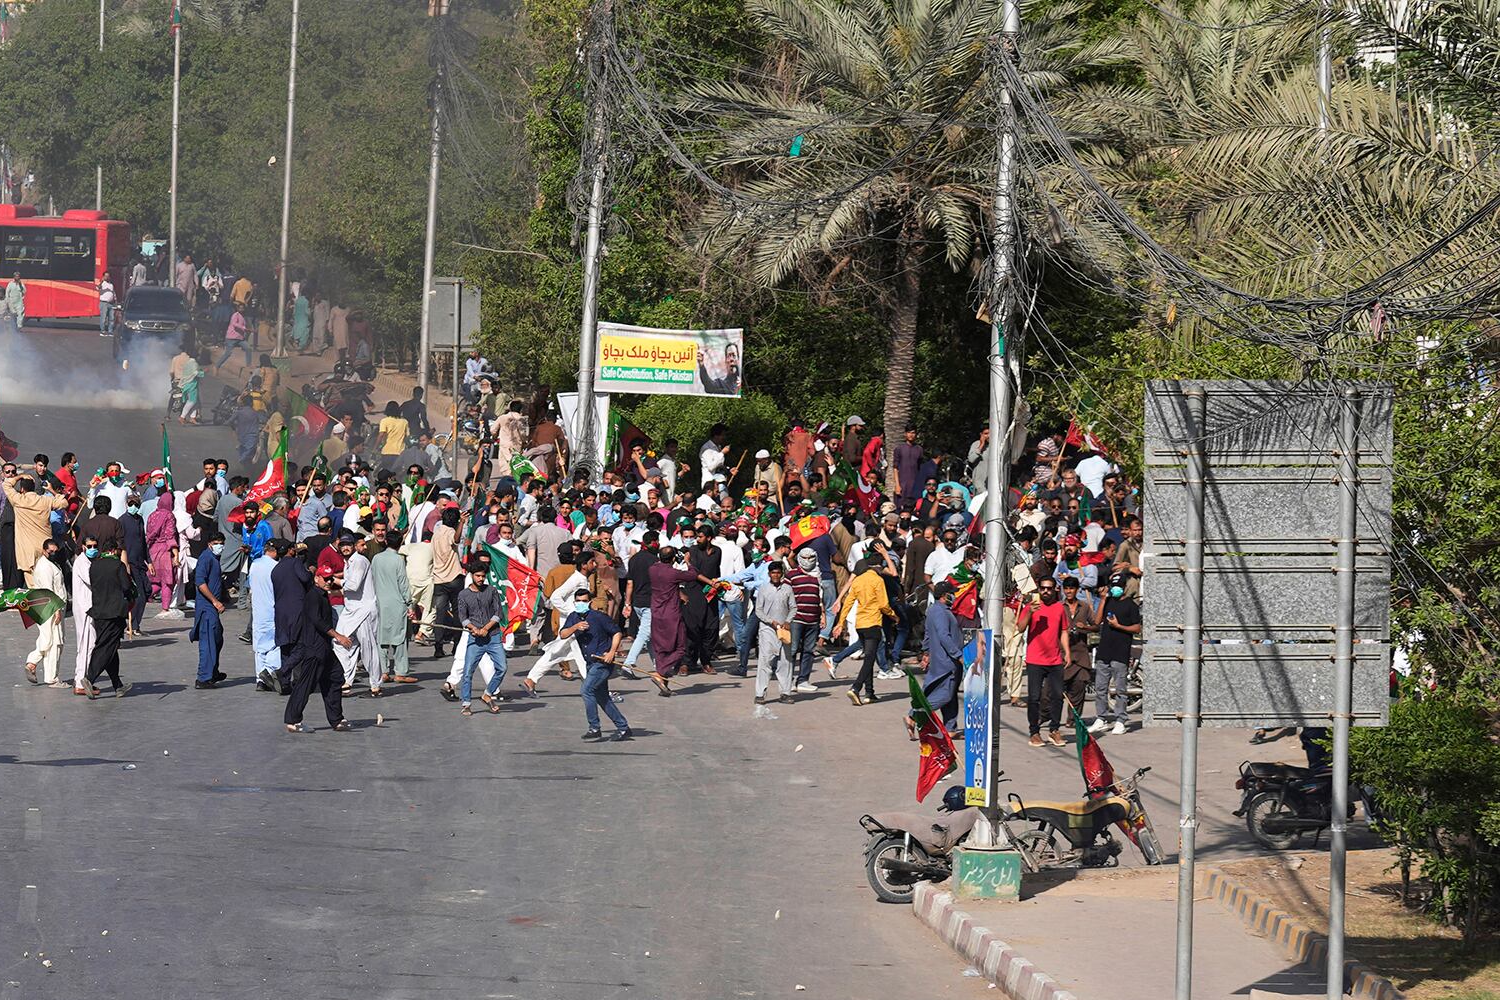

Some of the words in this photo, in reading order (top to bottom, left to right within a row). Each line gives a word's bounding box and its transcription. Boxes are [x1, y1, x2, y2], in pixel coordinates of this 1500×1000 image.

[603, 343, 624, 362] بچاؤ
[626, 345, 649, 358] ملک
[651, 346, 671, 364] بچاؤ
[673, 345, 694, 363] آئین
[602, 367, 616, 378] Safe
[655, 369, 668, 381] Safe
[668, 370, 693, 382] Pakistan
